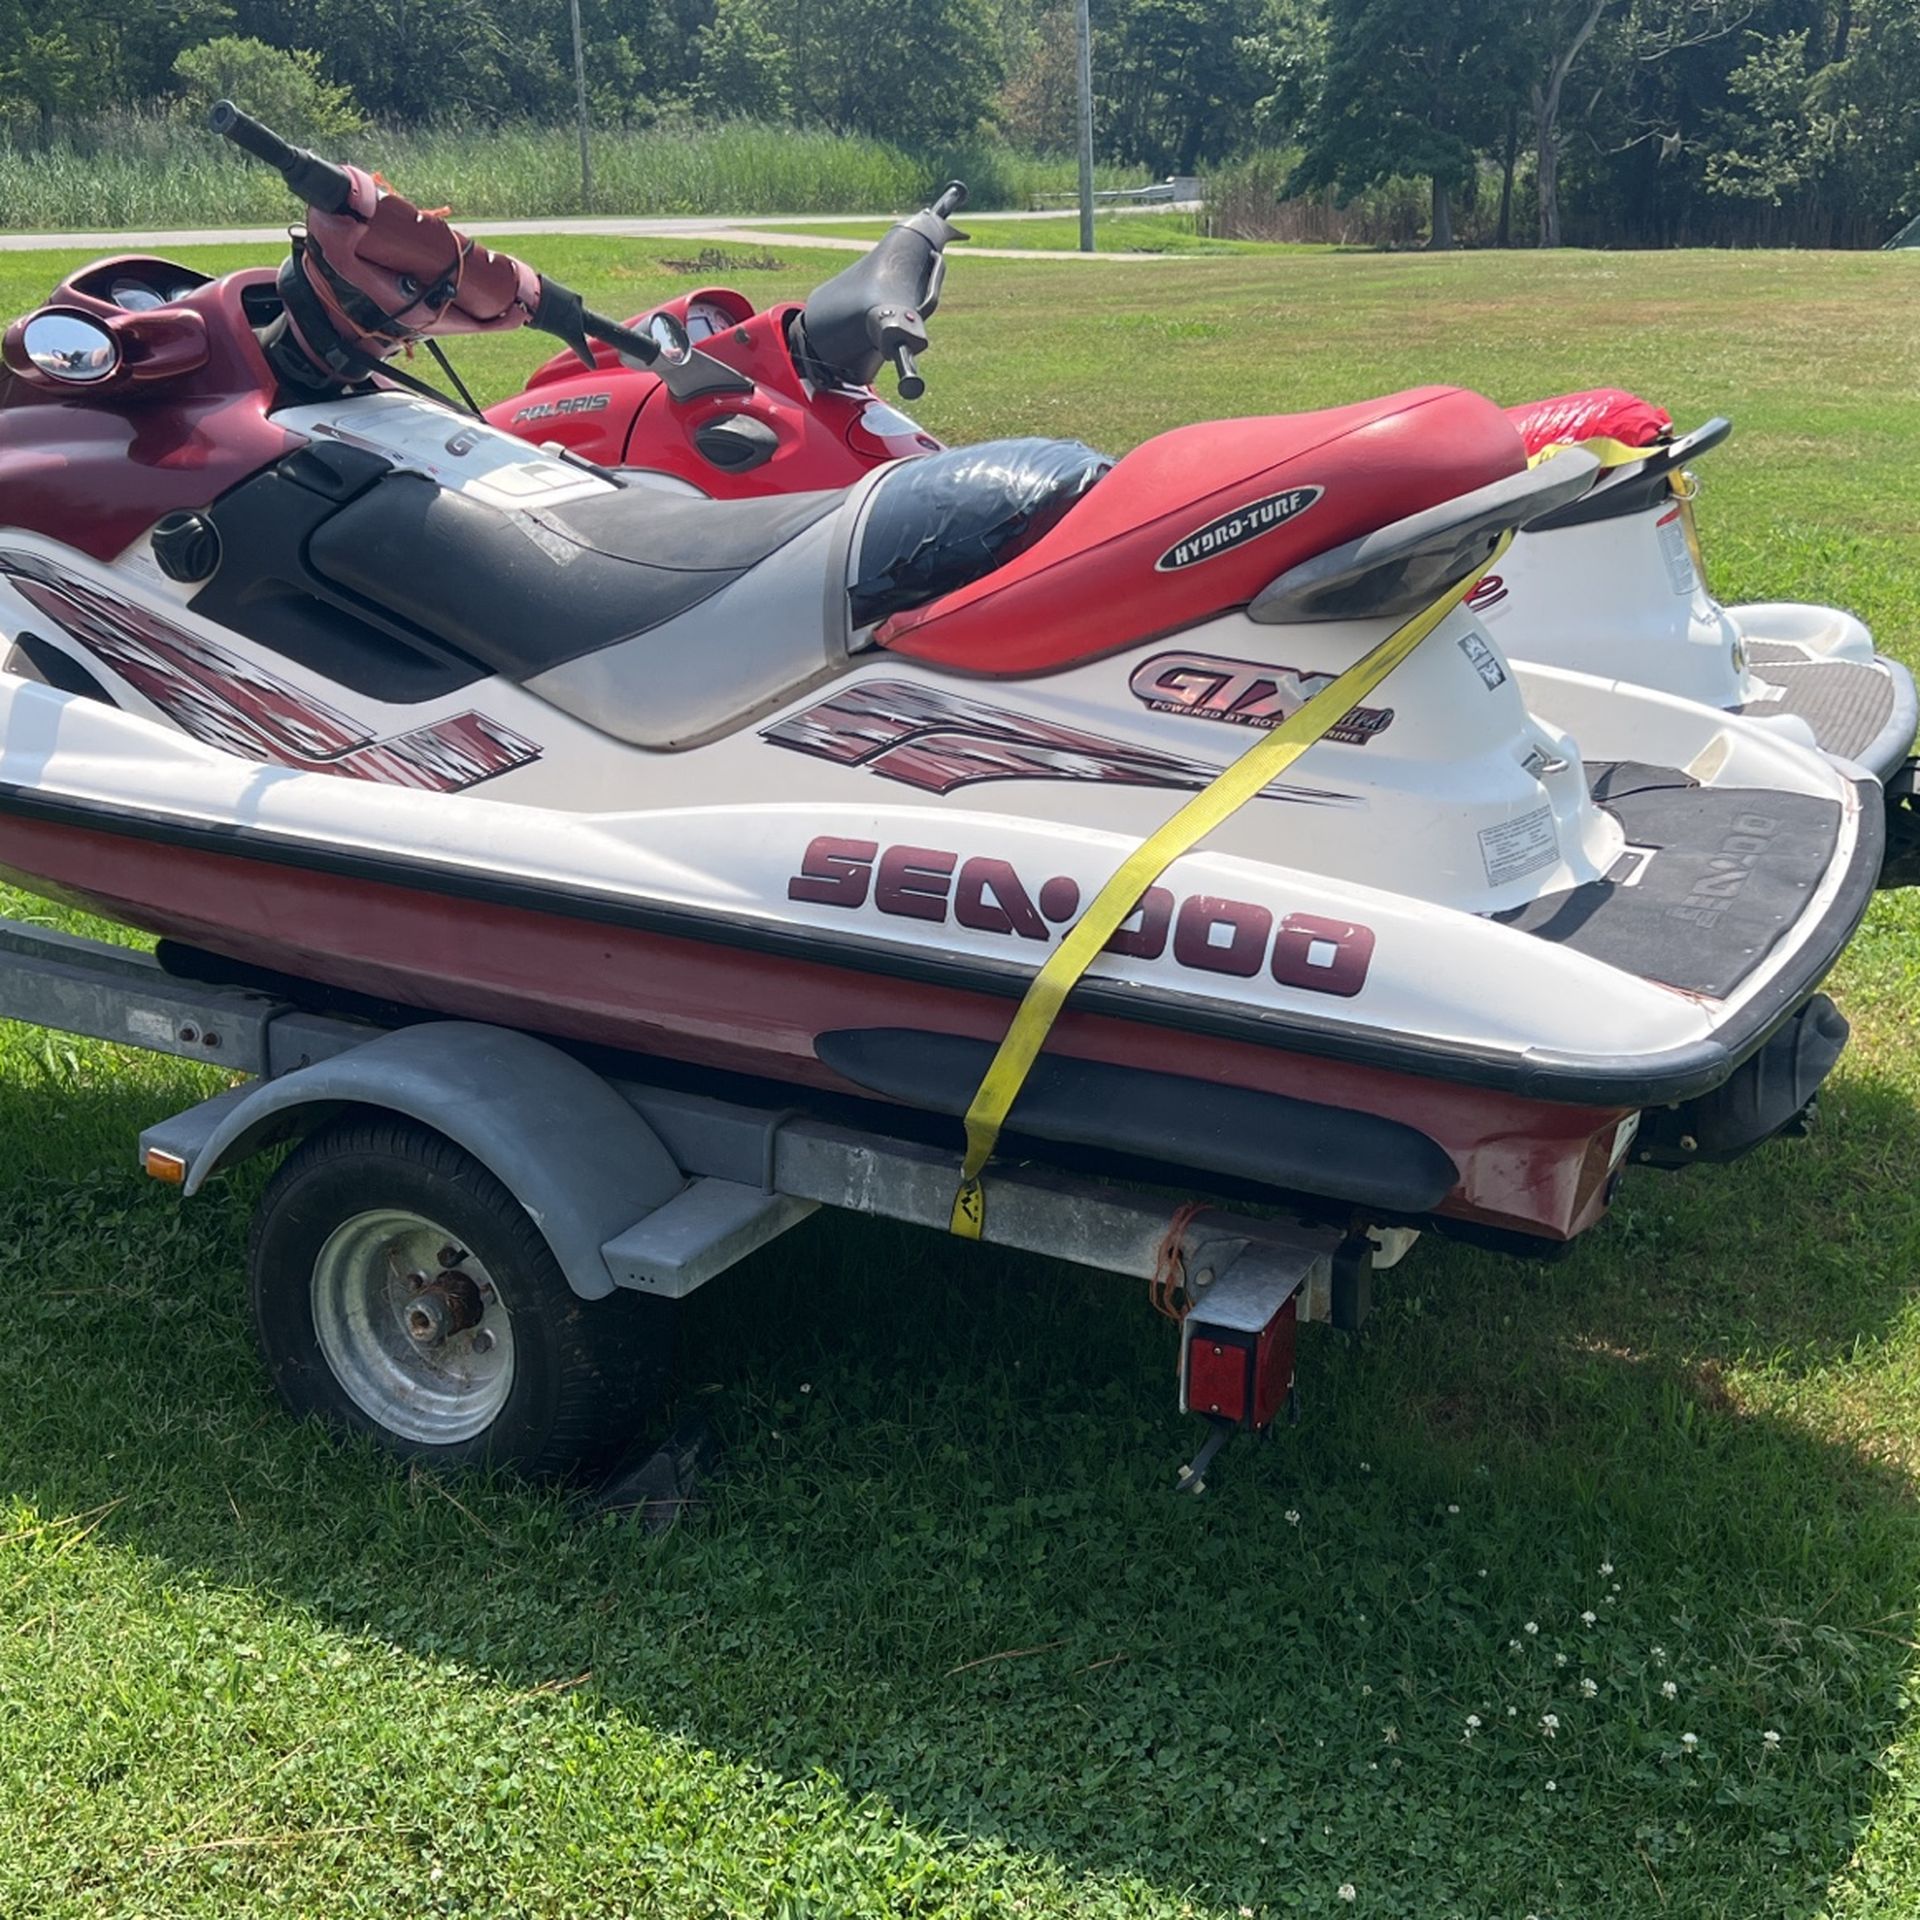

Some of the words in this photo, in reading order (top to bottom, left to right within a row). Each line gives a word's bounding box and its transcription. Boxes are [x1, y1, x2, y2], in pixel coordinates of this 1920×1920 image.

[512, 392, 611, 424] POLARIS
[1174, 492, 1301, 566] HYDRO-TURF
[1151, 701, 1222, 719] POWERED
[1223, 712, 1247, 723] BY
